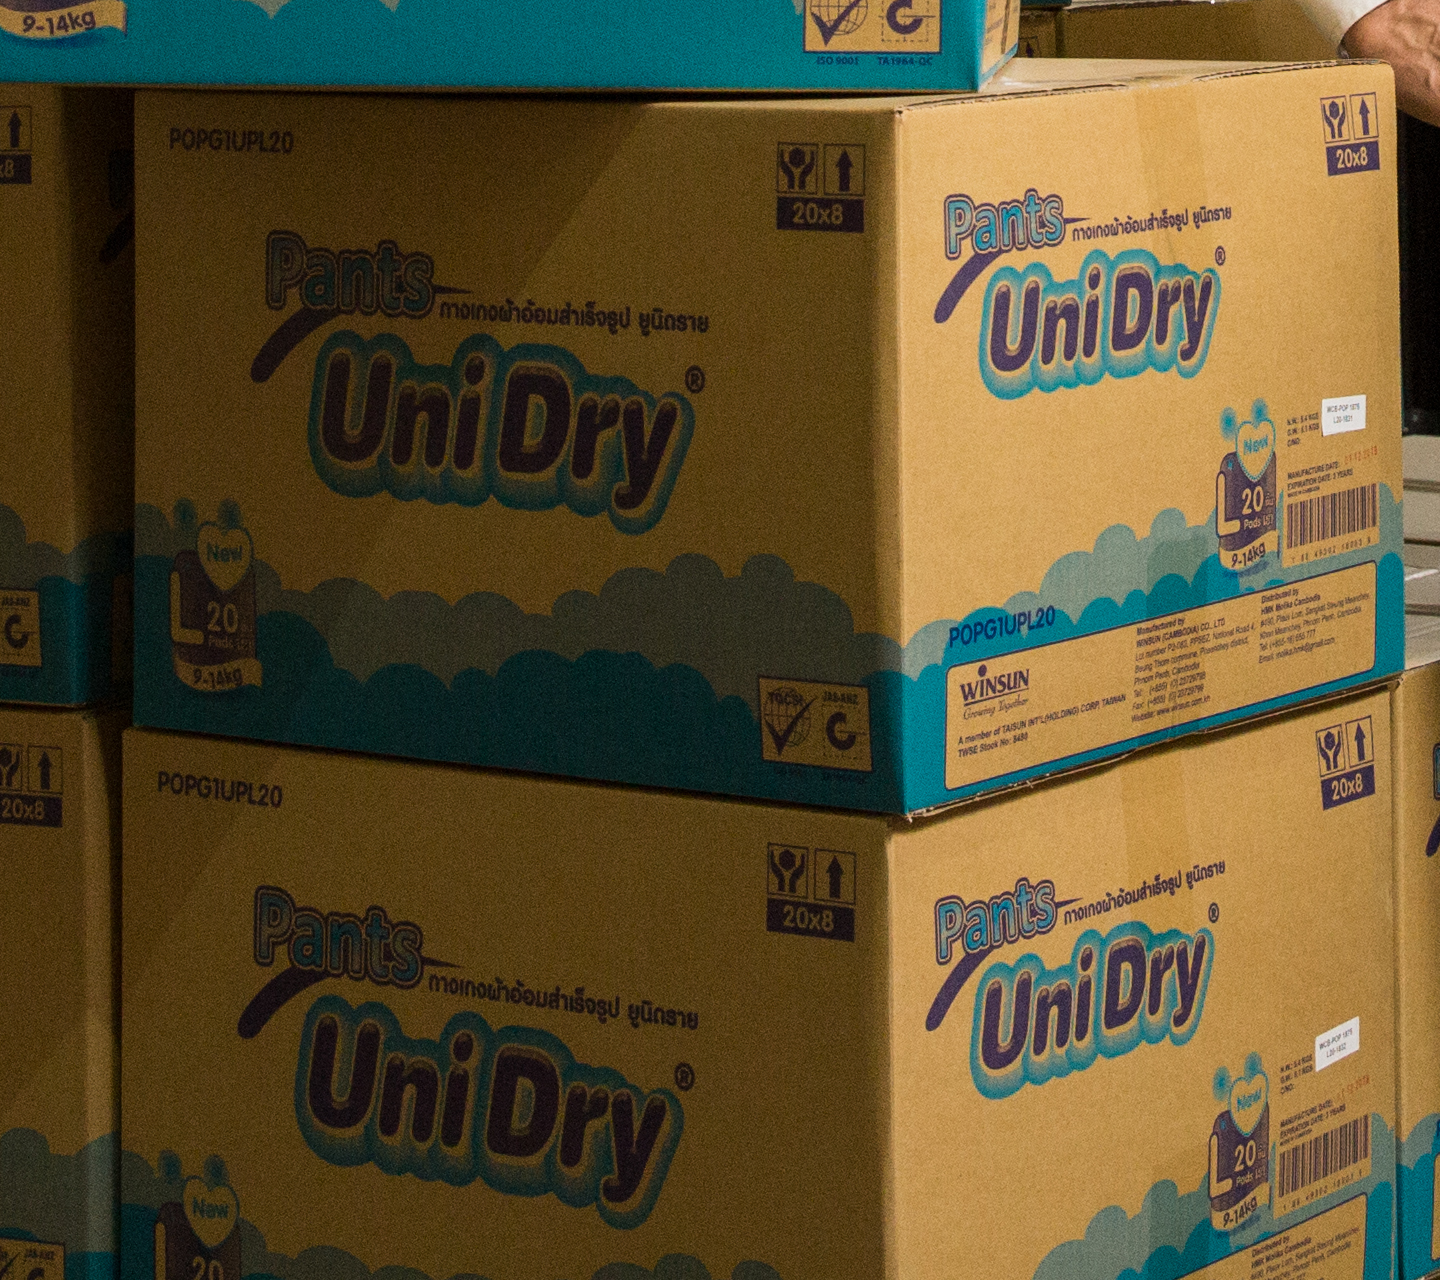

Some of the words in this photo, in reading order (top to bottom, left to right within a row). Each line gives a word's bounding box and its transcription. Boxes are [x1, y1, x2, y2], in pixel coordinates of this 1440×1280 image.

[23, 11, 96, 35] 9-14kg
[169, 128, 294, 154] POPG1UPL20
[1335, 147, 1370, 170] 20x8
[791, 201, 844, 227] 20x8
[944, 189, 1066, 259] Pants
[266, 229, 436, 318] Pants
[1243, 434, 1269, 455] New
[205, 540, 244, 565] New
[1231, 542, 1266, 568] 9-14kg
[949, 605, 1056, 648] POPG1UPL20
[960, 665, 1030, 702] WINSUN
[158, 770, 282, 809] POPG1UPL20
[1330, 772, 1364, 802] 20x8
[0, 798, 46, 822] 20x8
[781, 904, 836, 934] 20x8
[935, 877, 1058, 965] Pants
[253, 885, 423, 989] Pants
[191, 1196, 230, 1221] New
[1222, 1196, 1258, 1228] 9-14kg
